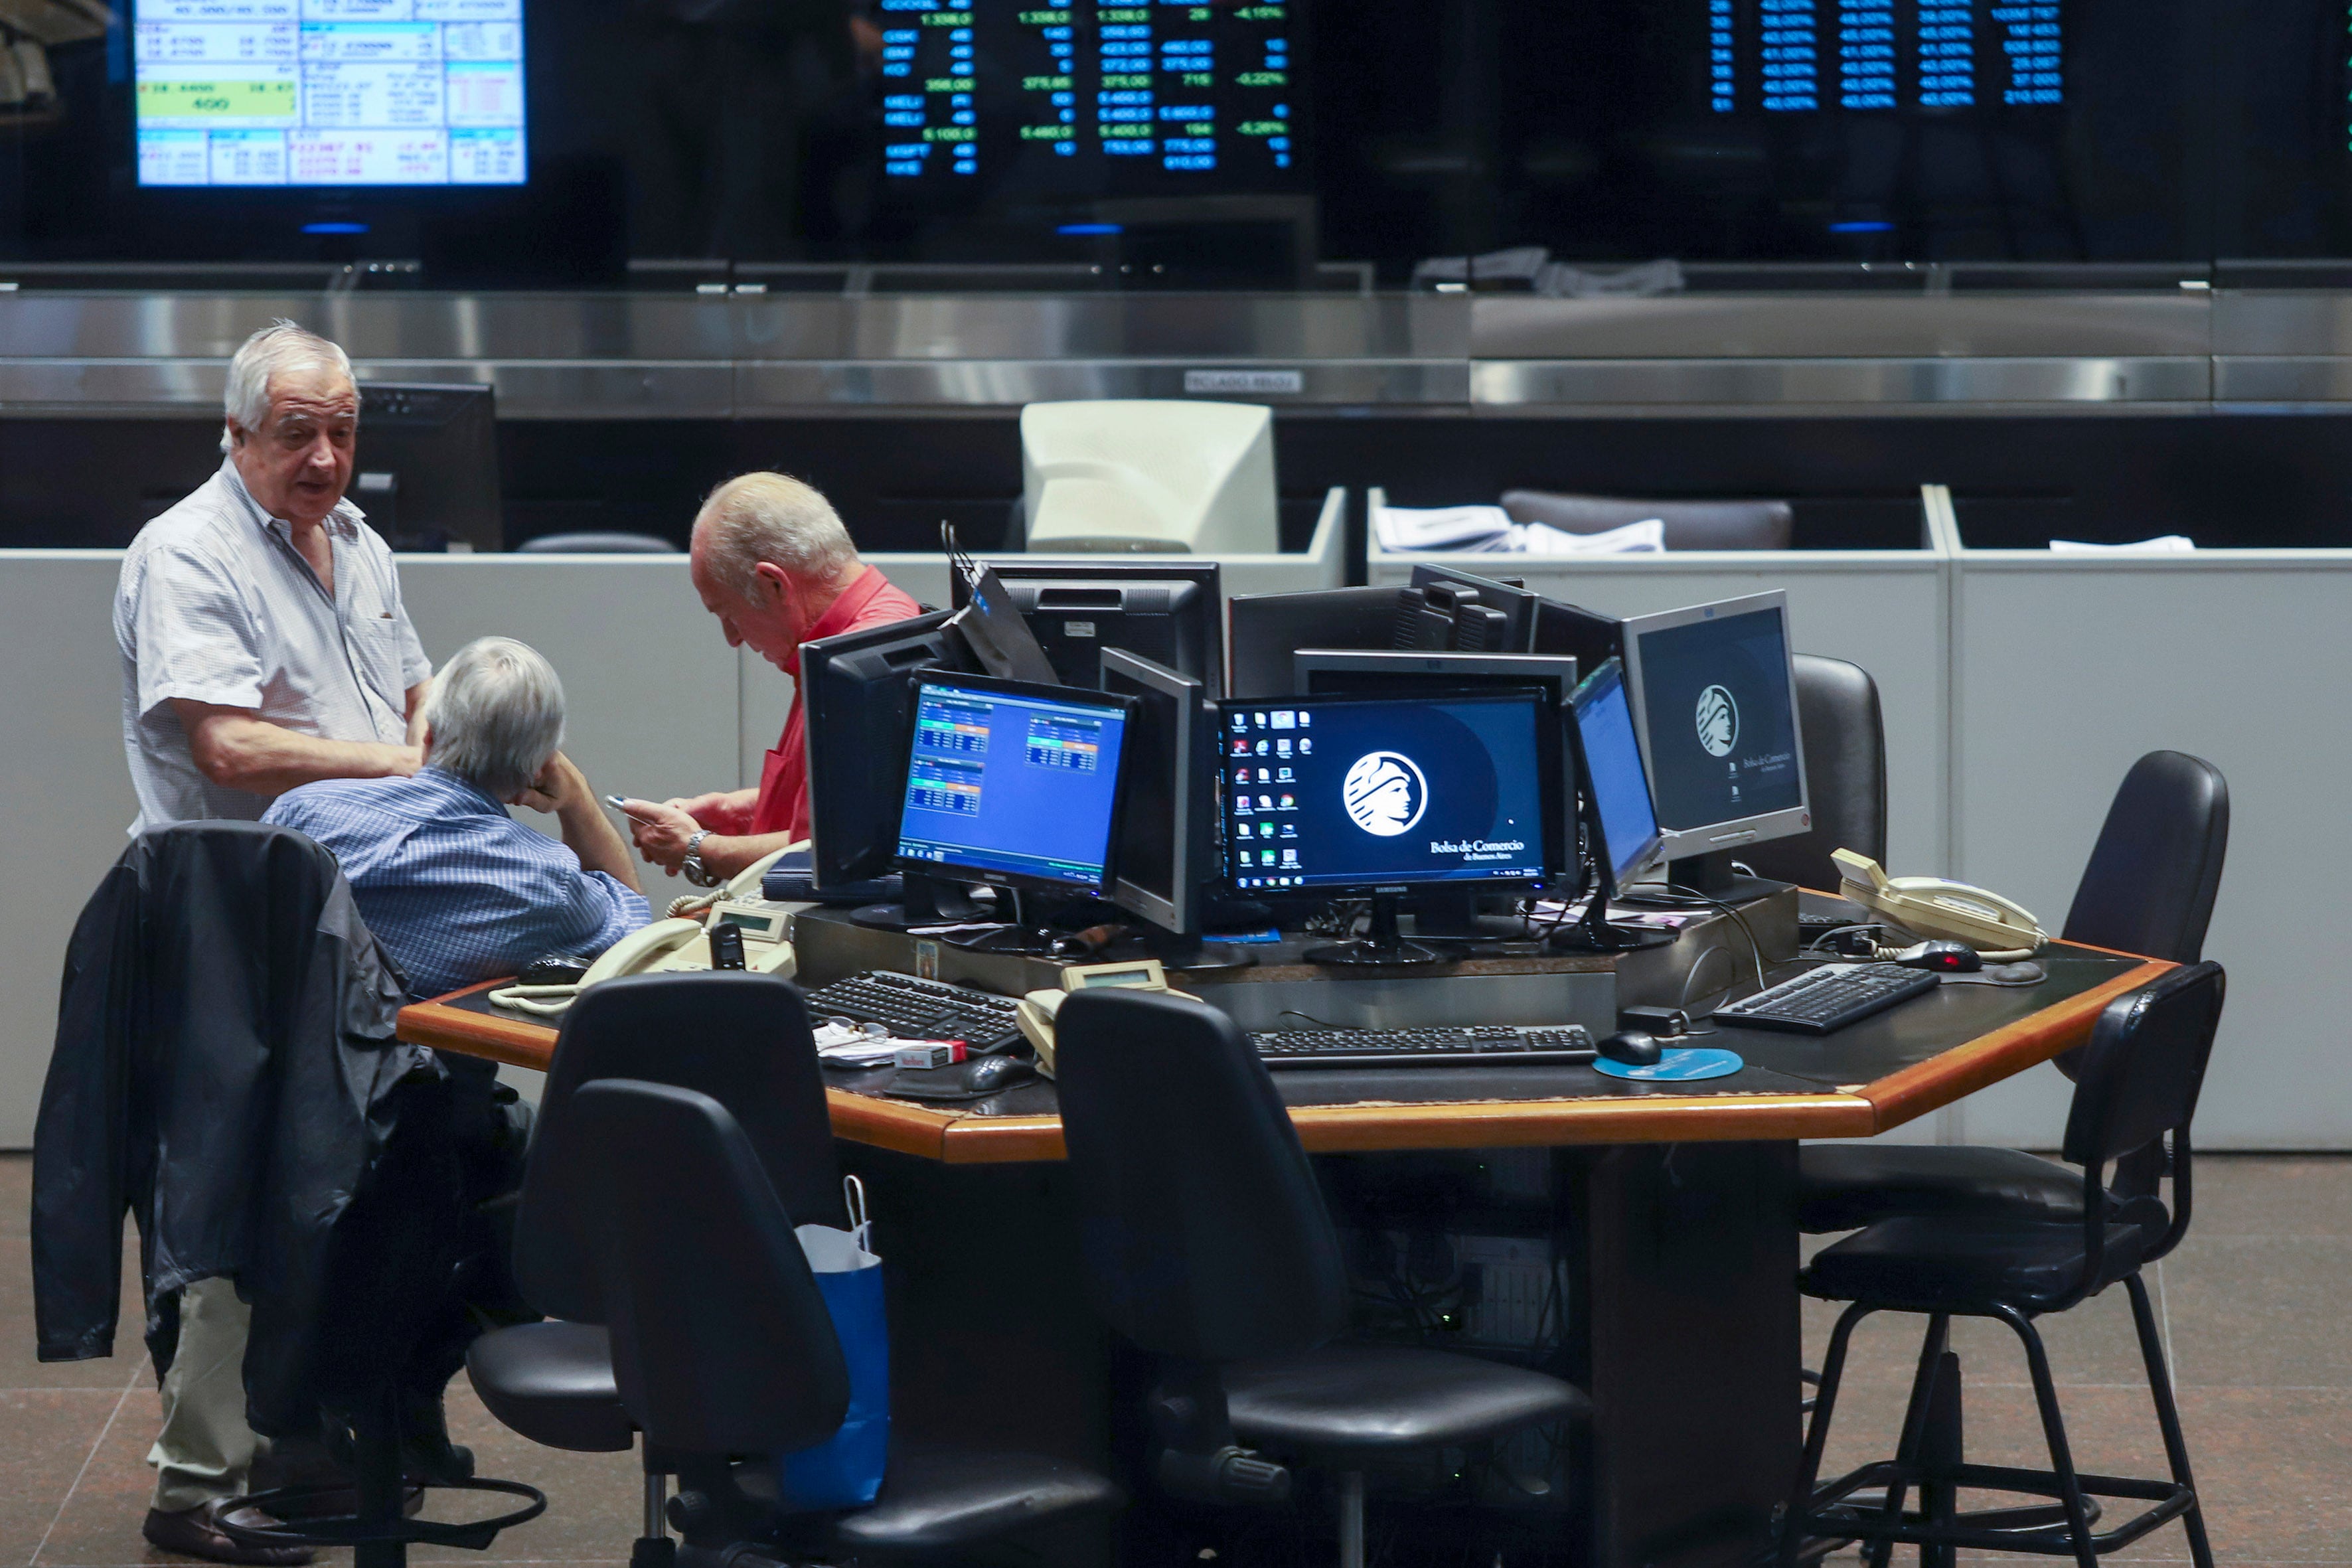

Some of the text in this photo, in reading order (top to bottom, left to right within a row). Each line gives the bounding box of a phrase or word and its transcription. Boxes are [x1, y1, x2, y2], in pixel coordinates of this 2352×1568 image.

[1430, 840, 1524, 853] Bolsa de Comercio
